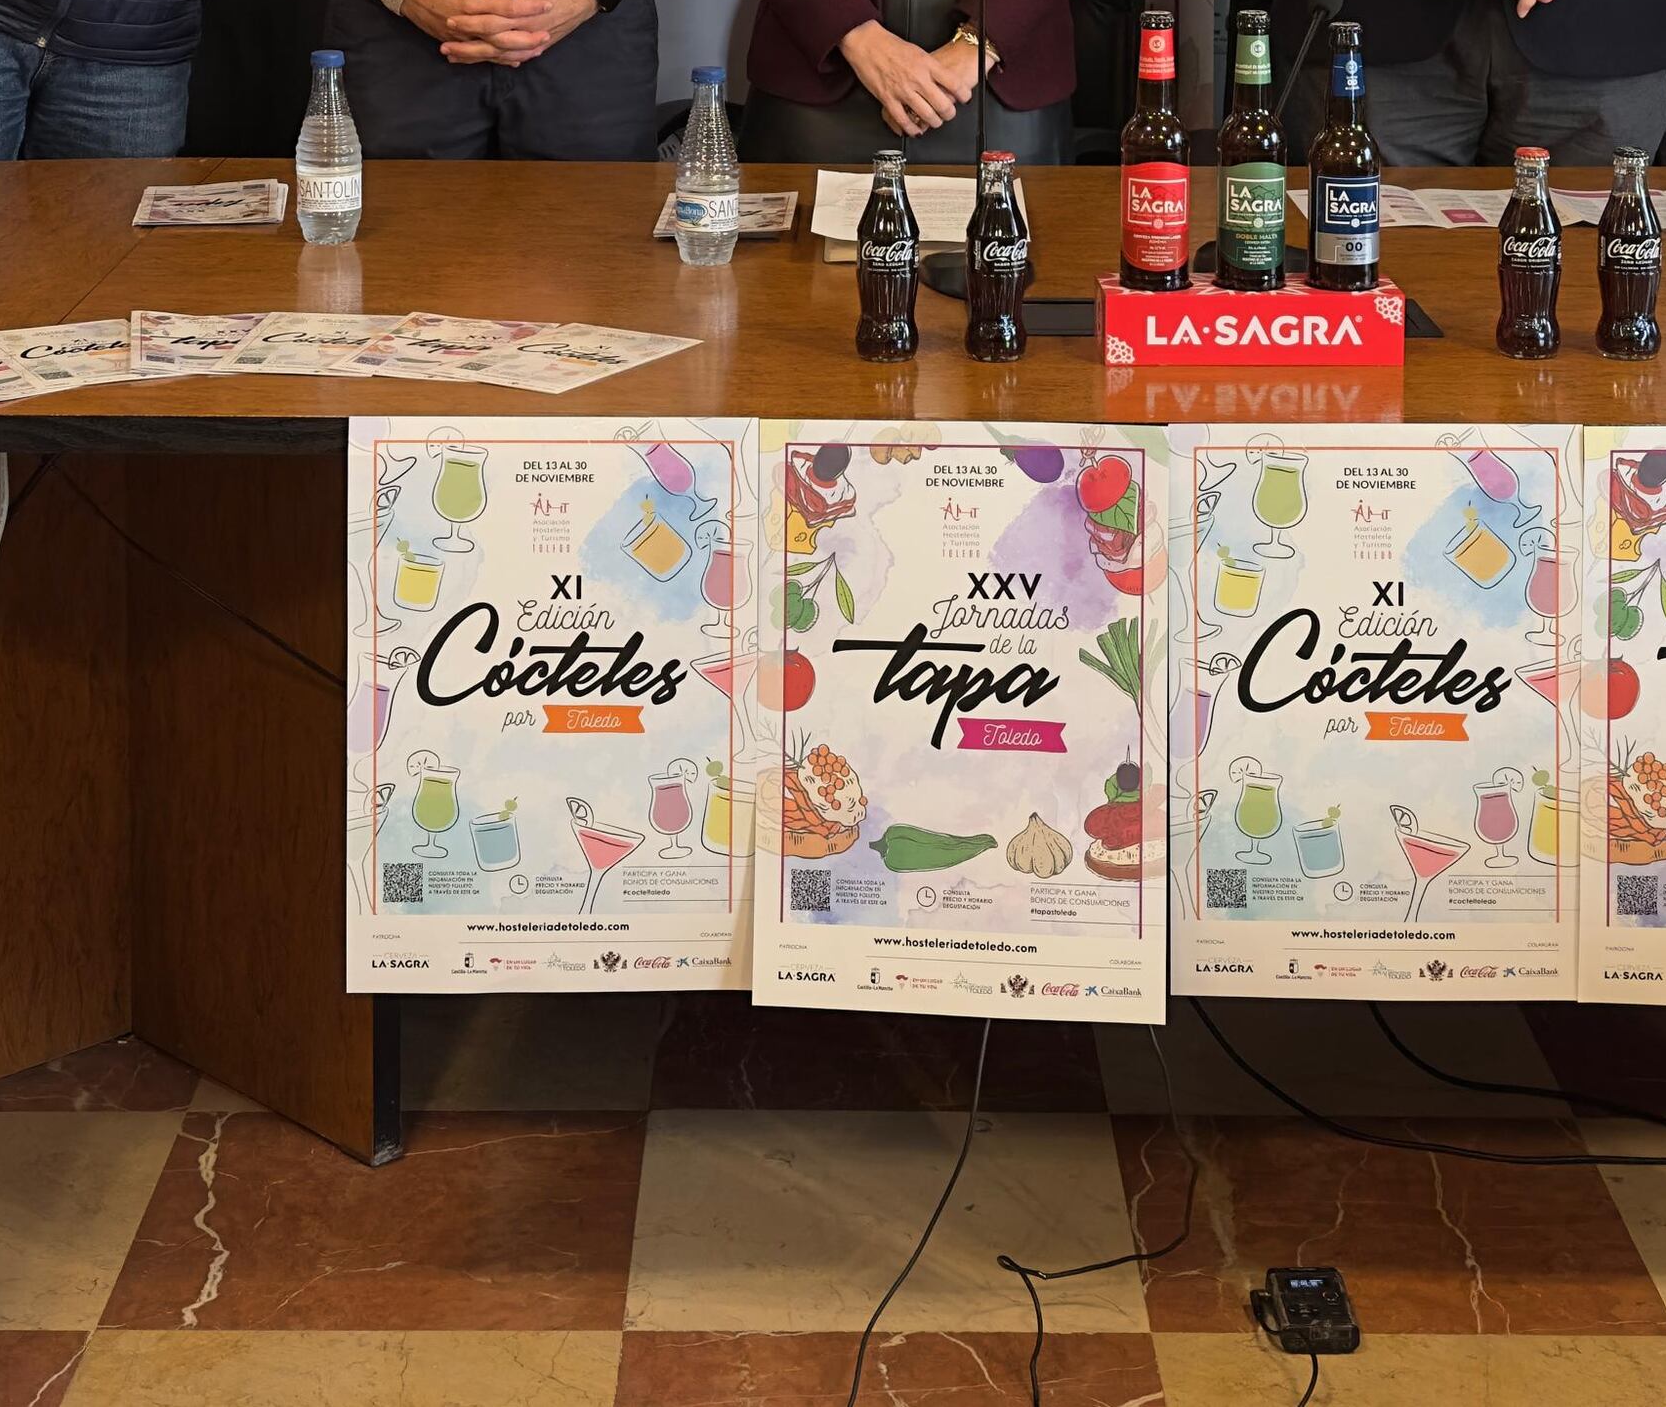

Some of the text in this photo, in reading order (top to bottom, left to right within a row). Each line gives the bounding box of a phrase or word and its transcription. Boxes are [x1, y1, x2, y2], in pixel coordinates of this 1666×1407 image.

[299, 176, 360, 199] SANTOLÍN
[1131, 185, 1152, 199] LA
[1231, 185, 1252, 199] LA
[1329, 190, 1350, 202] LA
[1131, 199, 1183, 213] SAGRA
[1231, 199, 1282, 213] SAGRA
[1329, 201, 1376, 214] SAGRA
[523, 461, 587, 470] DEL 13 AL 30
[934, 465, 997, 475] DEL 13 AL 30
[1344, 467, 1409, 477] DEL 13 AL 30
[515, 474, 595, 483] DE NOVIEMBRE
[925, 478, 1005, 488] DE NOVIEMBRE
[1336, 480, 1416, 490] DE NOVIEMBRE
[551, 574, 582, 600] XI
[967, 572, 1042, 600] XXV
[1372, 581, 1404, 606] XI
[517, 600, 615, 632] Edición
[930, 594, 1069, 639] Jornadas
[1338, 606, 1438, 638] Edición
[989, 634, 1037, 655] de la
[416, 602, 688, 707] Cócteles
[1237, 608, 1512, 713] Cócteles
[832, 622, 1060, 750] tapa
[501, 708, 622, 732] por Toledo
[1324, 716, 1446, 739] por Toledo
[983, 723, 1043, 747] Toledo
[467, 921, 630, 932] www.hosteleriadetoledo.com
[1291, 929, 1455, 941] www.hosteleriadetoledo.com
[874, 936, 1037, 953] www.hosteleriadetoledo.com
[691, 957, 732, 966] CaixaBank
[1518, 967, 1558, 975] CaixaBank
[1100, 985, 1142, 996] CaixaBank
